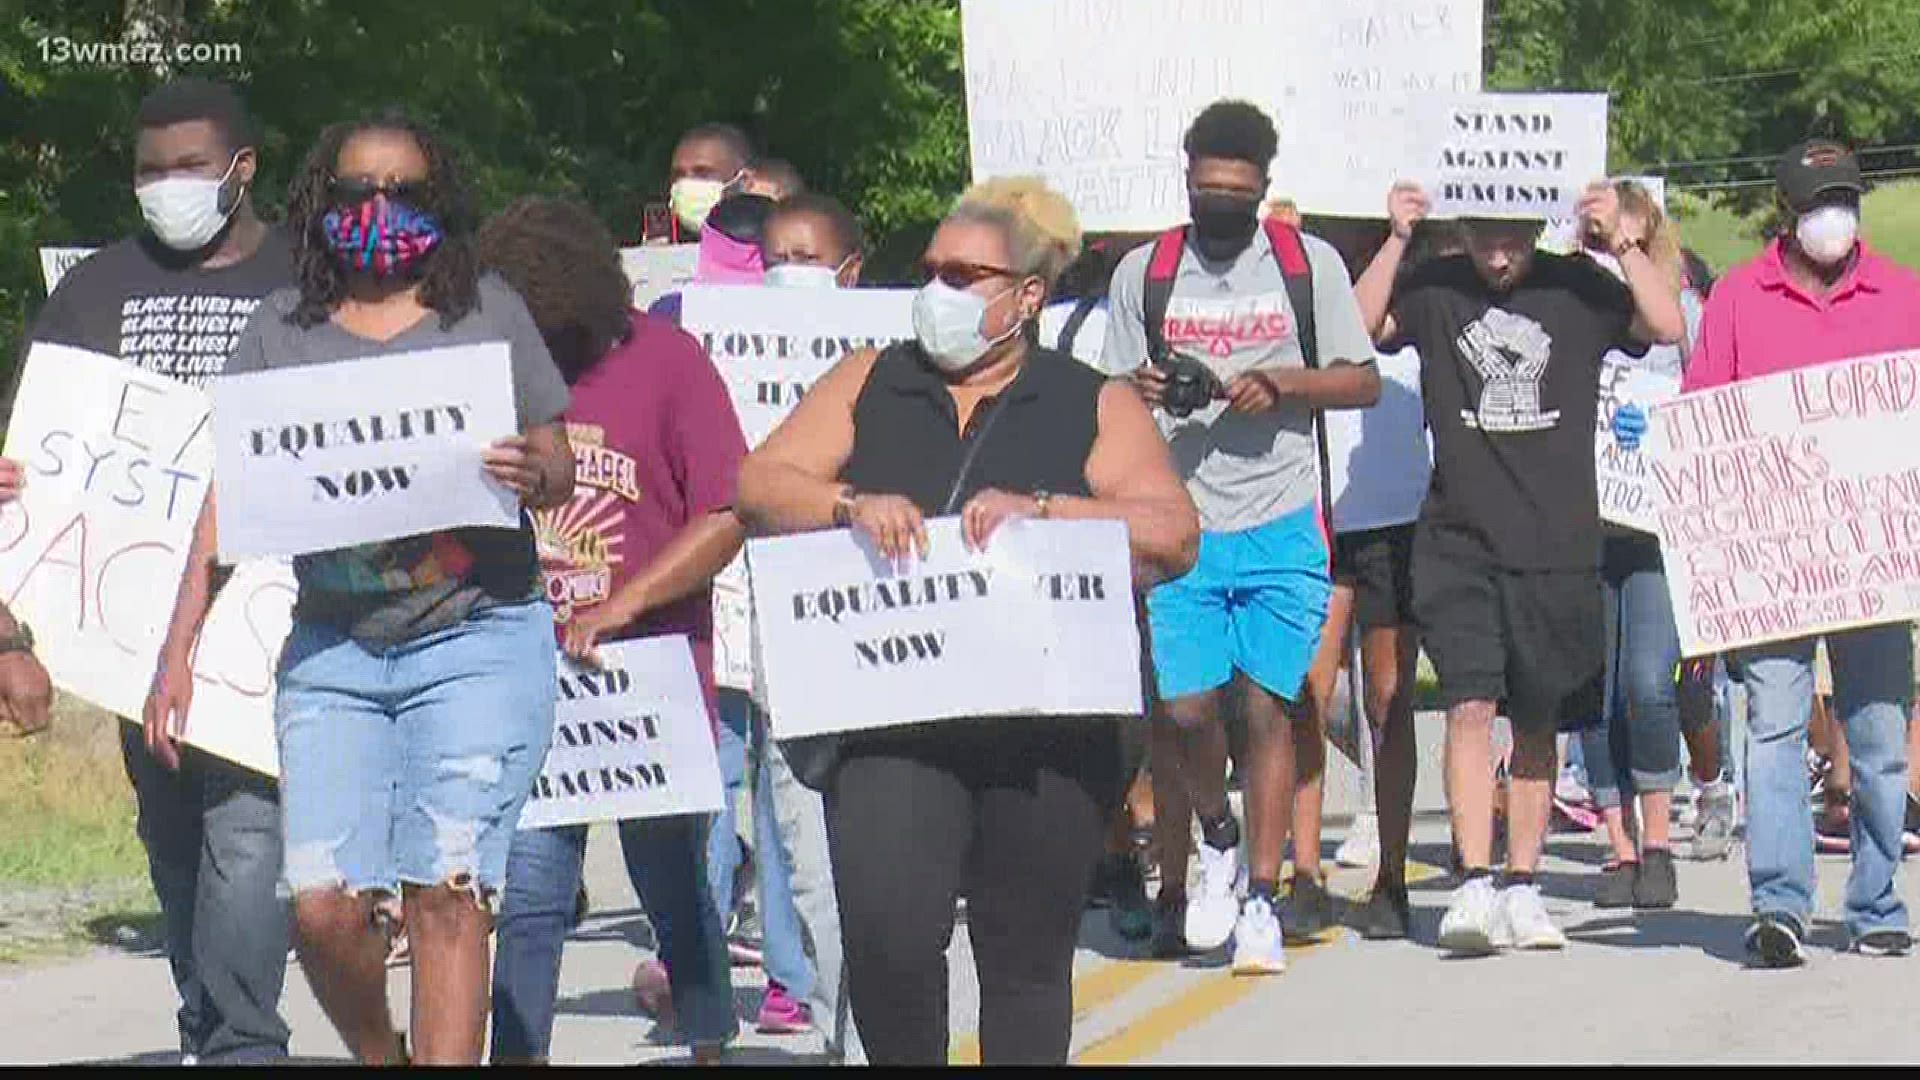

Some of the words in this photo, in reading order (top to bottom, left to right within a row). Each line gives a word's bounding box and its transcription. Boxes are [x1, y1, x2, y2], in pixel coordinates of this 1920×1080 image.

[1452, 113, 1554, 133] STAND
[1438, 149, 1568, 172] AGAINST
[1441, 183, 1561, 204] RACISM
[122, 297, 177, 316] BLACK
[178, 295, 230, 315] LIVES
[121, 315, 176, 333] BLACK
[178, 315, 230, 333] LIVES
[120, 334, 175, 353] BLACK
[177, 334, 227, 353] LIVES
[700, 331, 794, 359] LOVE
[1791, 356, 1918, 425] LORD
[245, 402, 471, 461] EQUALITY
[310, 464, 418, 501] NOW
[1650, 431, 1831, 507] WORKS
[790, 571, 996, 625] EQUALITY
[854, 628, 947, 668] NOW
[531, 761, 672, 800] RACISM
